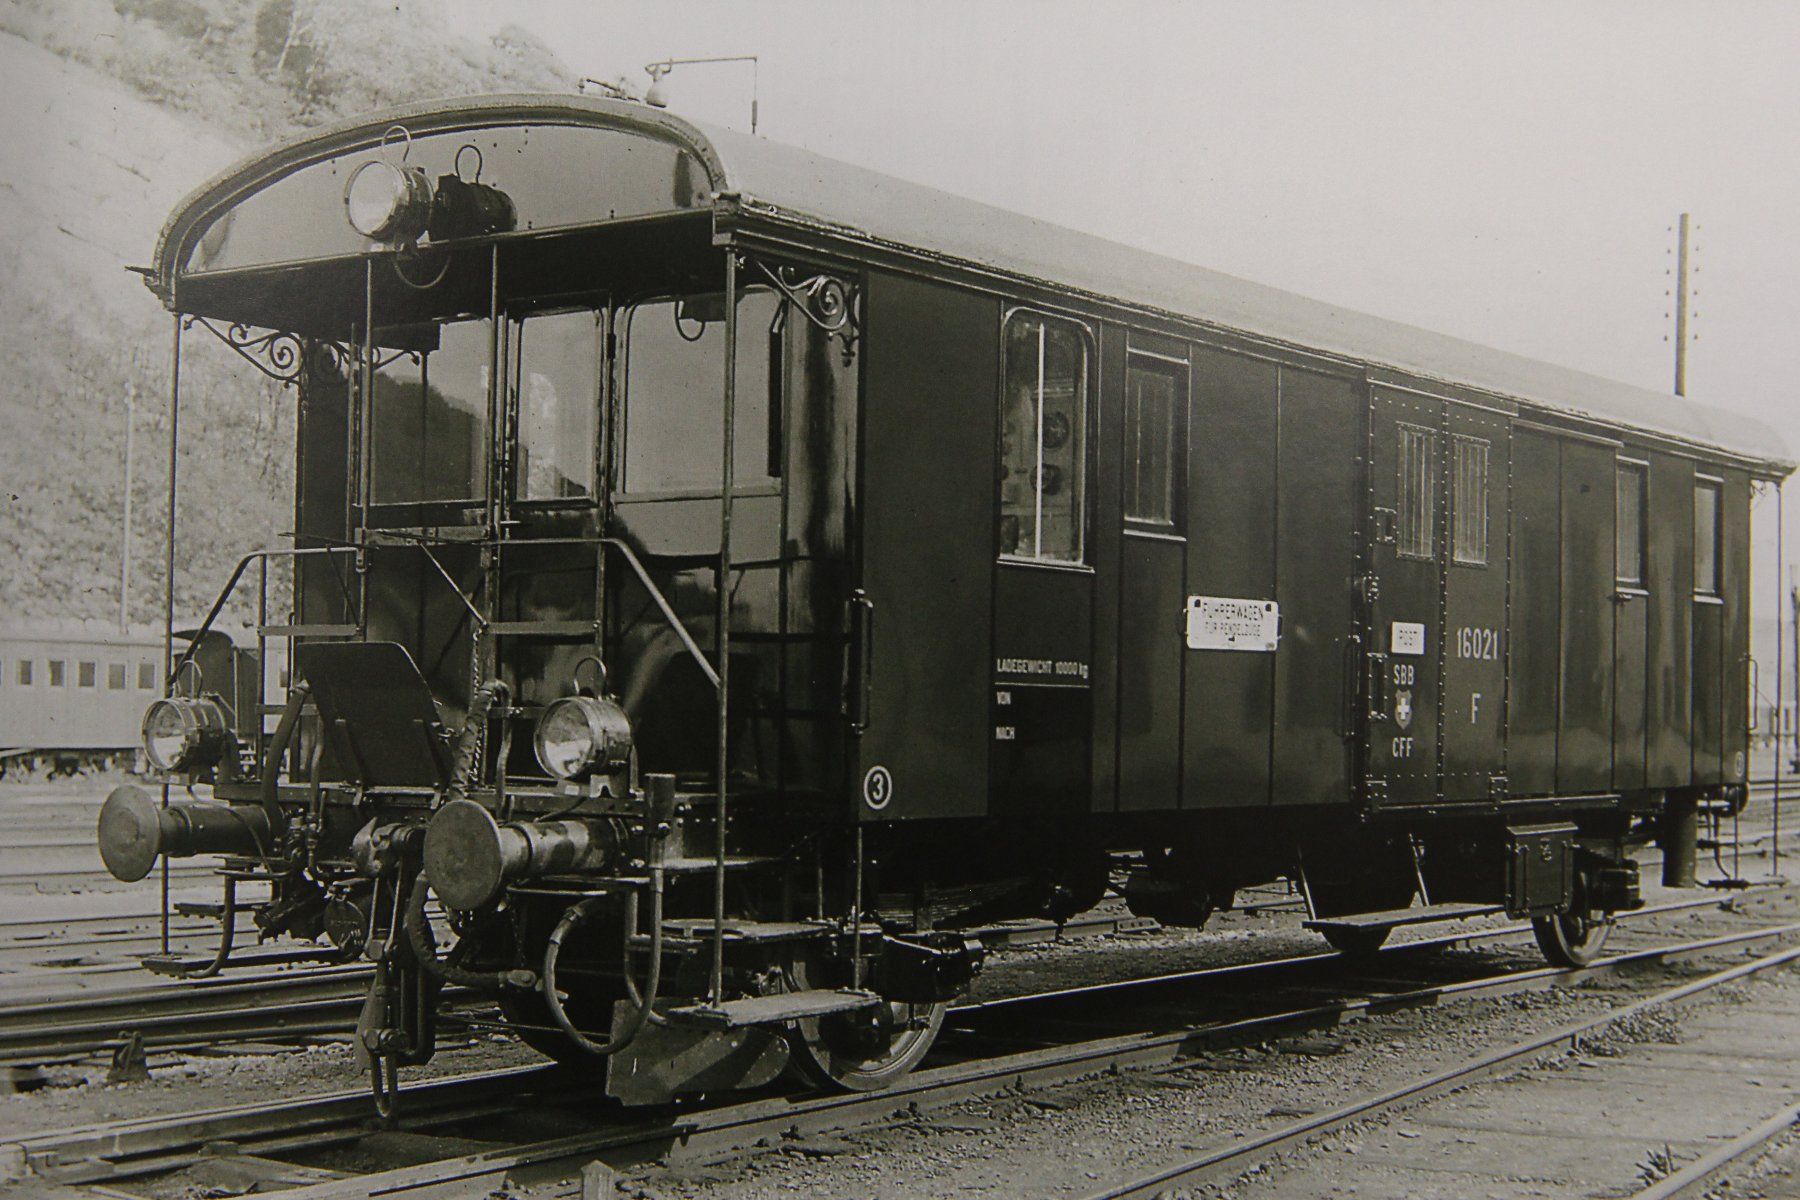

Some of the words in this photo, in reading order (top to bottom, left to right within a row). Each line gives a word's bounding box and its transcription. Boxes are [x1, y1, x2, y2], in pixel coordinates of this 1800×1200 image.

[1457, 627, 1498, 660] 16021
[1394, 664, 1415, 685] SBB
[1471, 692, 1481, 724] F
[1393, 737, 1414, 757] CFF
[873, 773, 884, 800] 3
